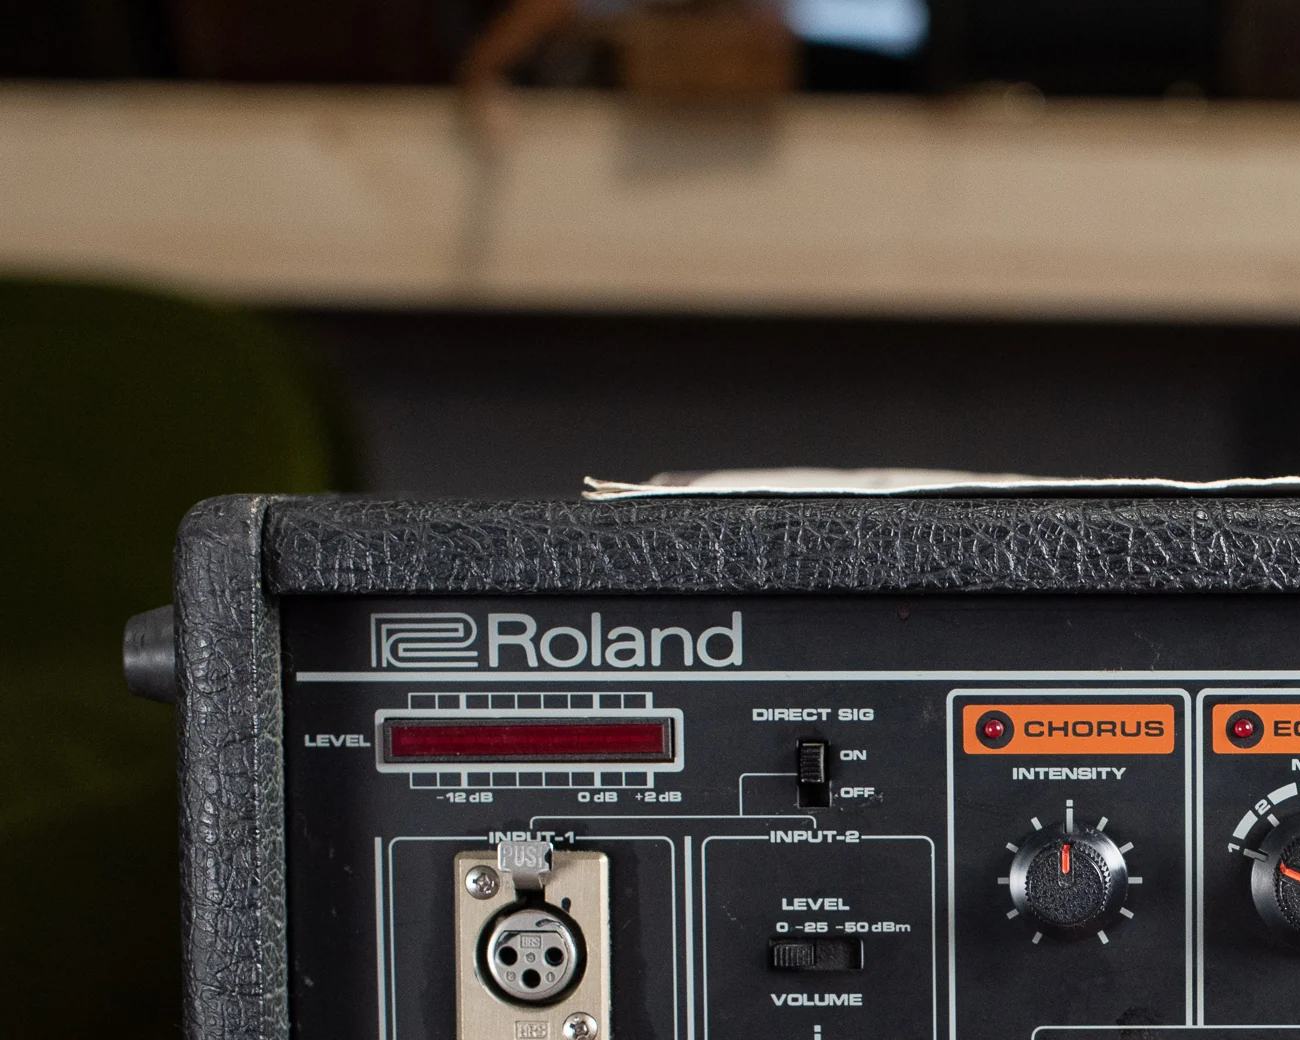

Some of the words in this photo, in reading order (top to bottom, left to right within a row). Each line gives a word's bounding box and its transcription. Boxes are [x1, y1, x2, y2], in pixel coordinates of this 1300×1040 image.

[488, 611, 743, 668] Roland
[752, 708, 832, 722] DIRECT
[837, 708, 875, 722] SIG
[1024, 720, 1165, 738] CHORUS
[304, 734, 371, 748] LEVEL
[839, 750, 867, 761] ON
[1012, 767, 1127, 780] INTENSITY
[840, 787, 875, 798] OFF
[1254, 799, 1271, 815] 2
[770, 830, 860, 843] INPUT-2
[781, 898, 850, 910] LEVEL
[776, 922, 789, 932] 0
[770, 994, 863, 1006] VOLUME
